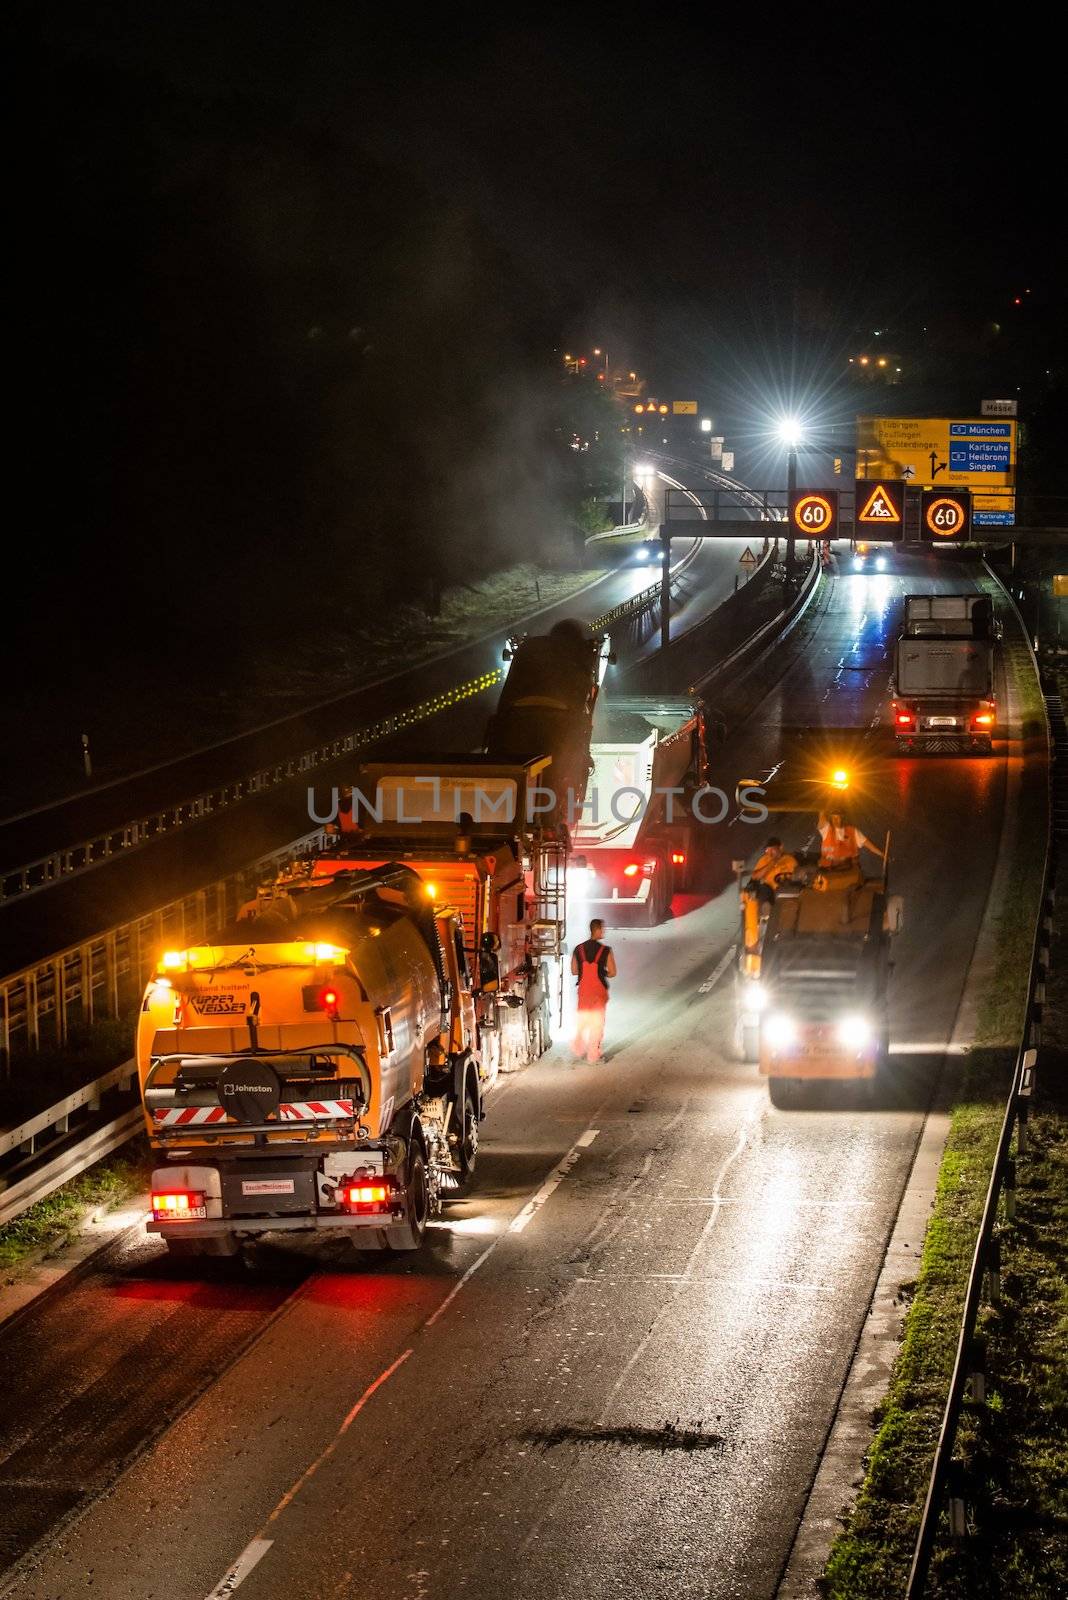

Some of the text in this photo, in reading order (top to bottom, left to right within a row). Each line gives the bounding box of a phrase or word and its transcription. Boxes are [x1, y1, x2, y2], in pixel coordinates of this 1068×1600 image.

[969, 425, 1005, 434] München
[969, 443, 1009, 452] Karlsruhe
[969, 453, 1008, 461] Heilbronn
[969, 462, 997, 472] Singen
[803, 507, 824, 524] 60
[935, 509, 956, 526] 60
[235, 1083, 273, 1093] Johnston
